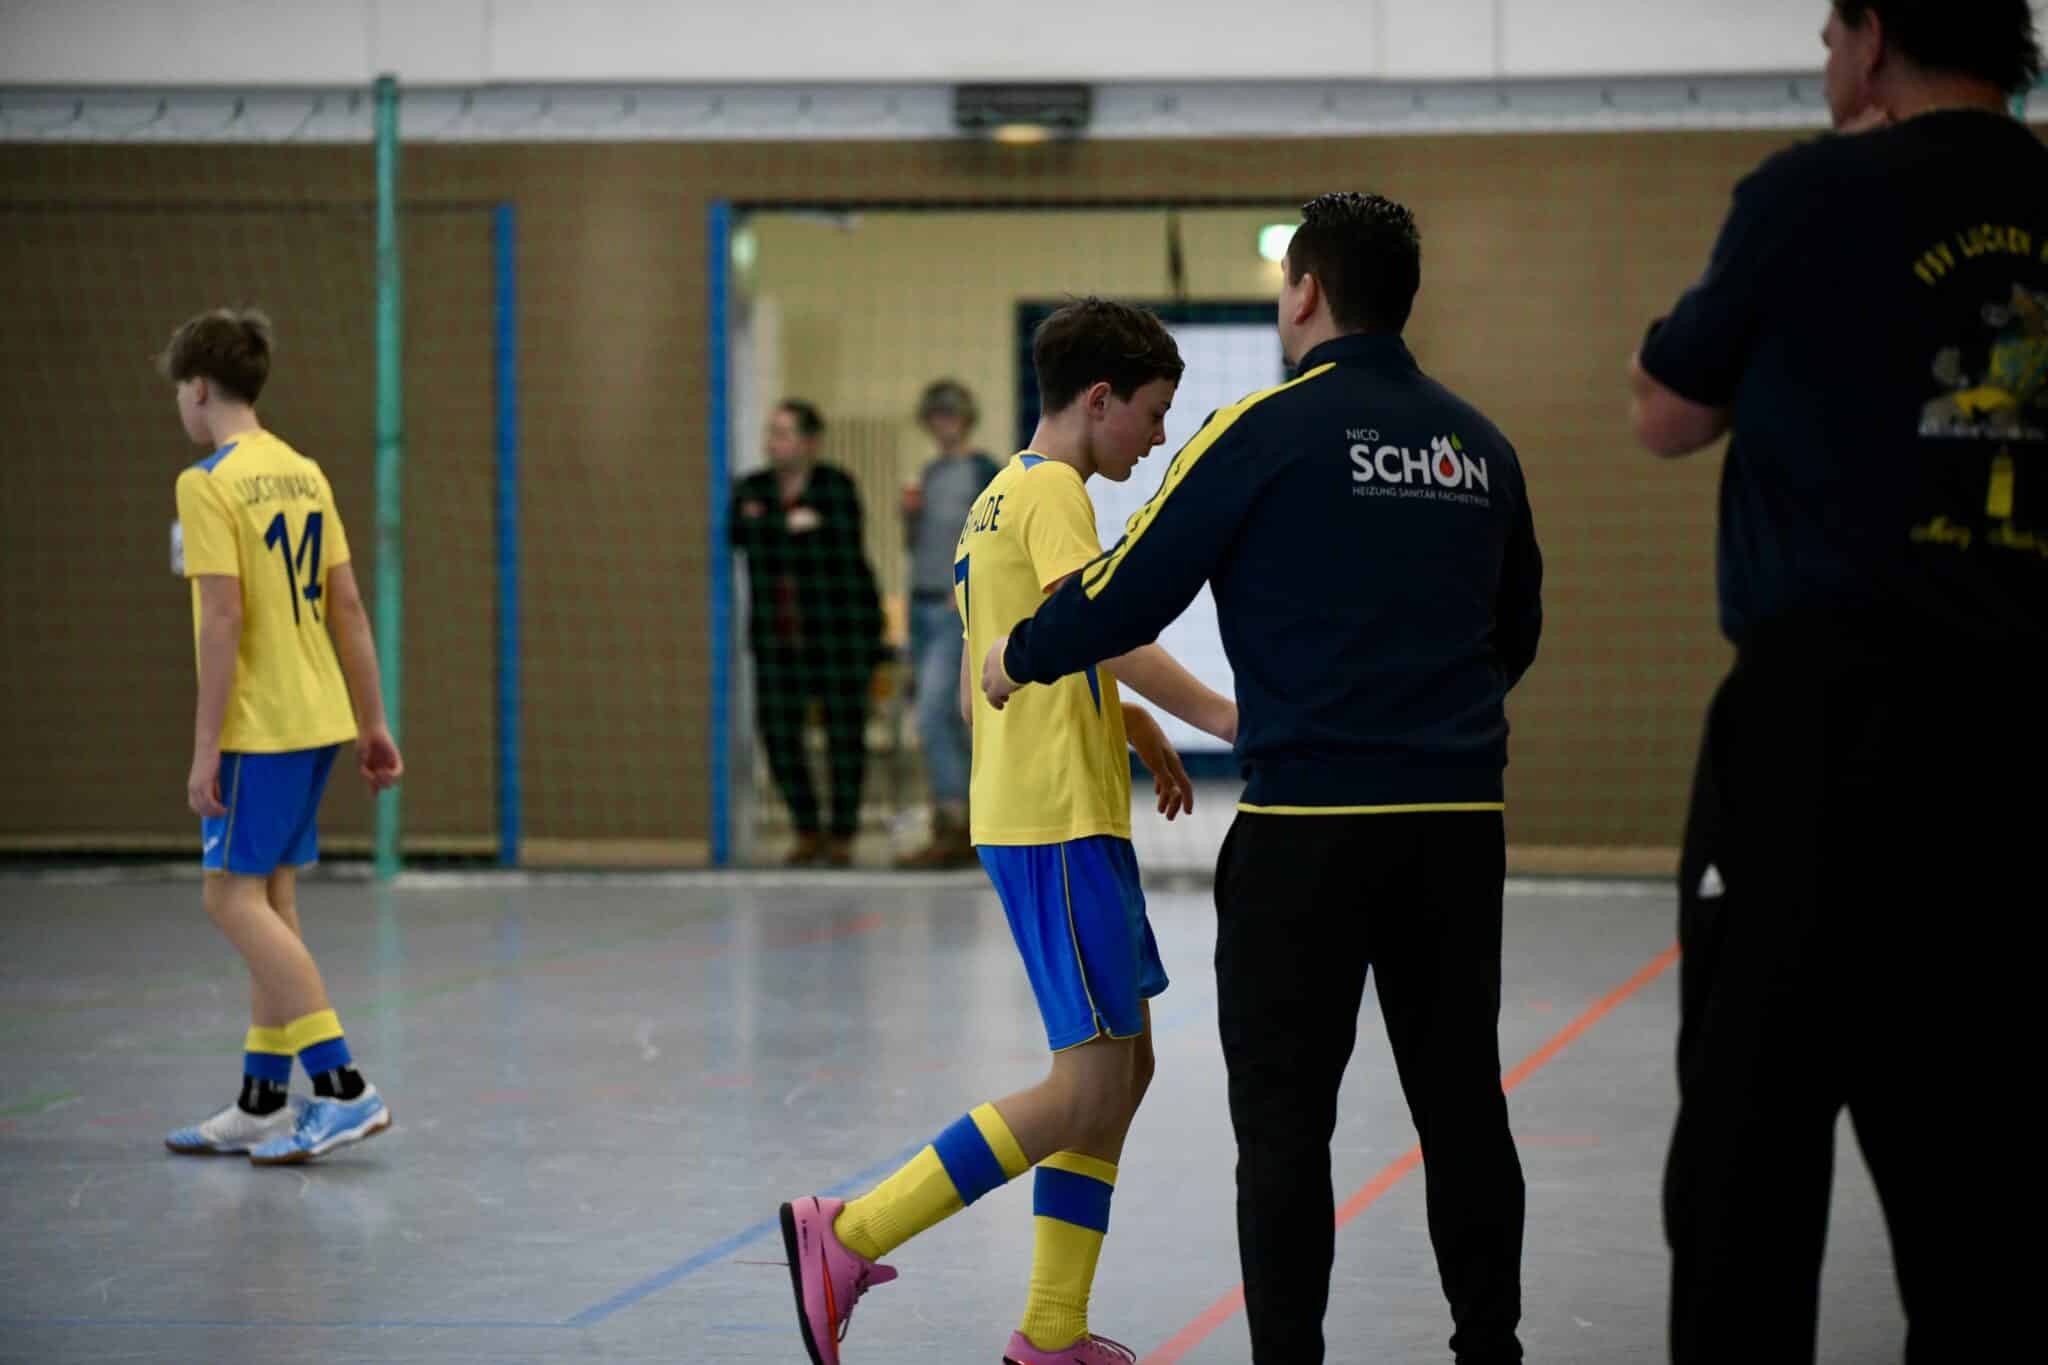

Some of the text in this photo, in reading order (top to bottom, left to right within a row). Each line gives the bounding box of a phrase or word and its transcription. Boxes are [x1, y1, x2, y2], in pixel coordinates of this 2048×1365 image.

[1346, 427, 1380, 442] NICO
[1349, 434, 1489, 492] SCHÖN
[1352, 485, 1397, 498] HEIZUNG
[264, 512, 323, 625] 14
